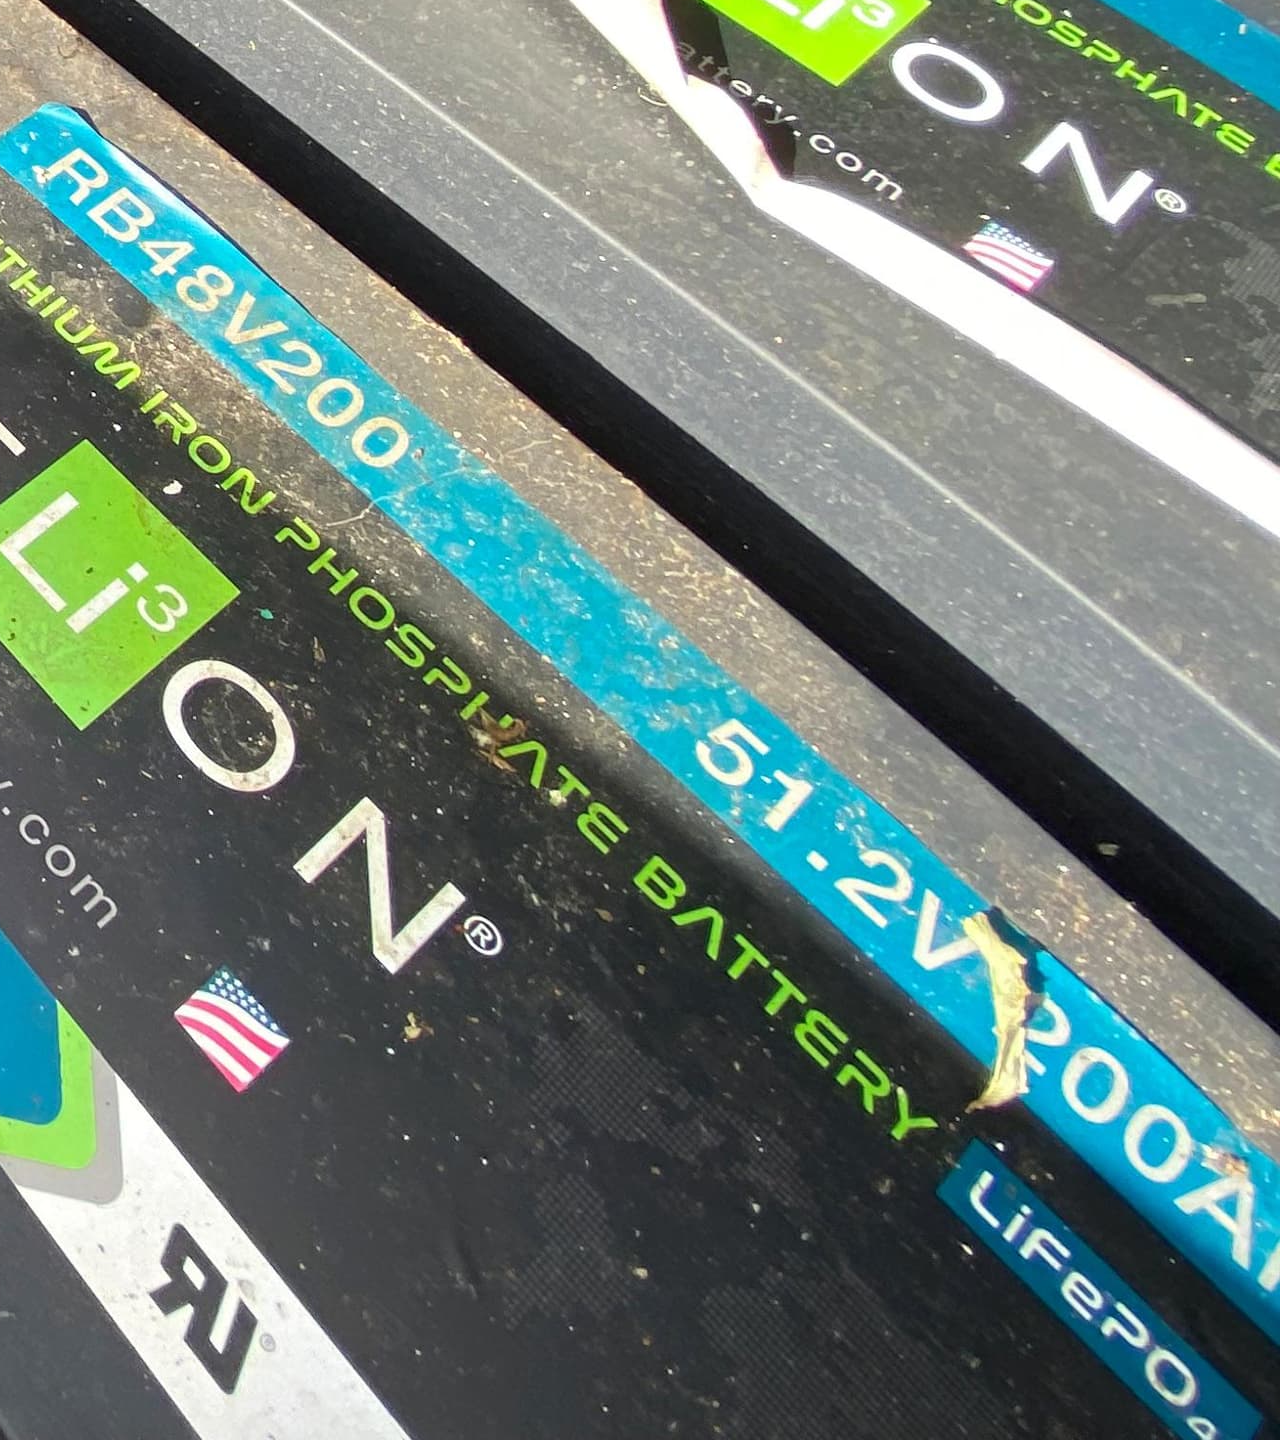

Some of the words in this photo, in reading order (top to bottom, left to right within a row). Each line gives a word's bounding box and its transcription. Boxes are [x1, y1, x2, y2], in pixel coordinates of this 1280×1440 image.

[40, 147, 408, 468] RB48V200
[695, 719, 990, 971] 51.2V
[140, 387, 275, 516] IRON
[275, 516, 628, 856] PHOSPHATE
[634, 856, 938, 1140] BATTERY
